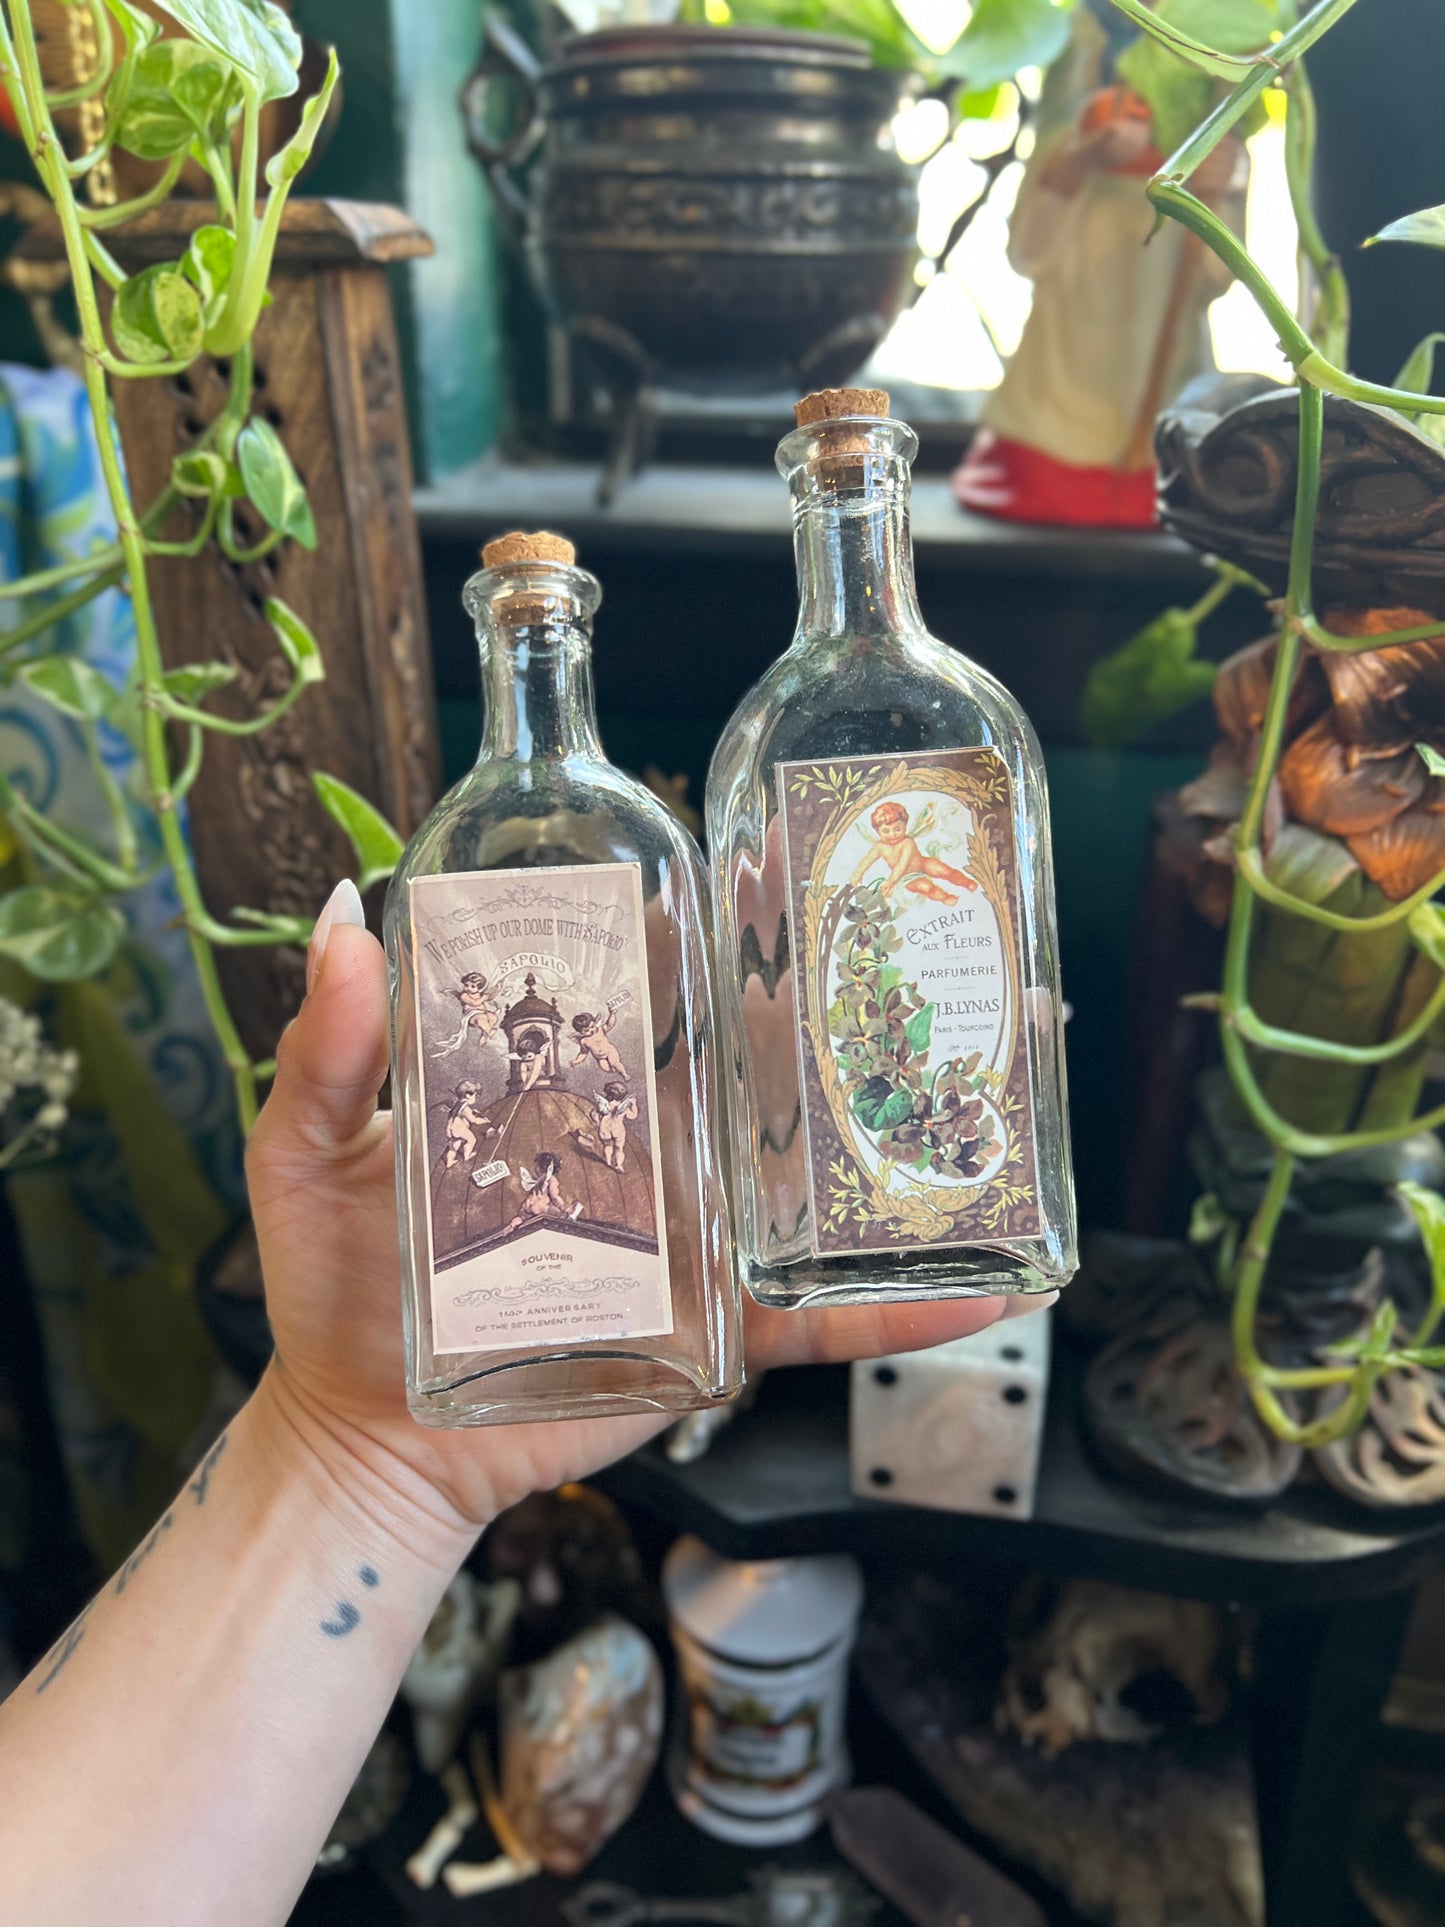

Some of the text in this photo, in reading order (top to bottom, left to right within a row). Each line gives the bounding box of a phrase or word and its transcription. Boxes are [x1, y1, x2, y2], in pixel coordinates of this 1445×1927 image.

[482, 923, 498, 942] UP
[500, 919, 522, 939] OUR
[523, 918, 554, 936] DOME
[557, 919, 583, 940] WITH
[499, 953, 566, 974] SAPOLIO
[921, 965, 998, 980] PARFUMERIE
[521, 1252, 573, 1266] SOUVENIR
[475, 1324, 488, 1332] OF
[490, 1322, 508, 1331] THE
[511, 1317, 568, 1329] SETTLEMENT
[571, 1316, 584, 1324] OF
